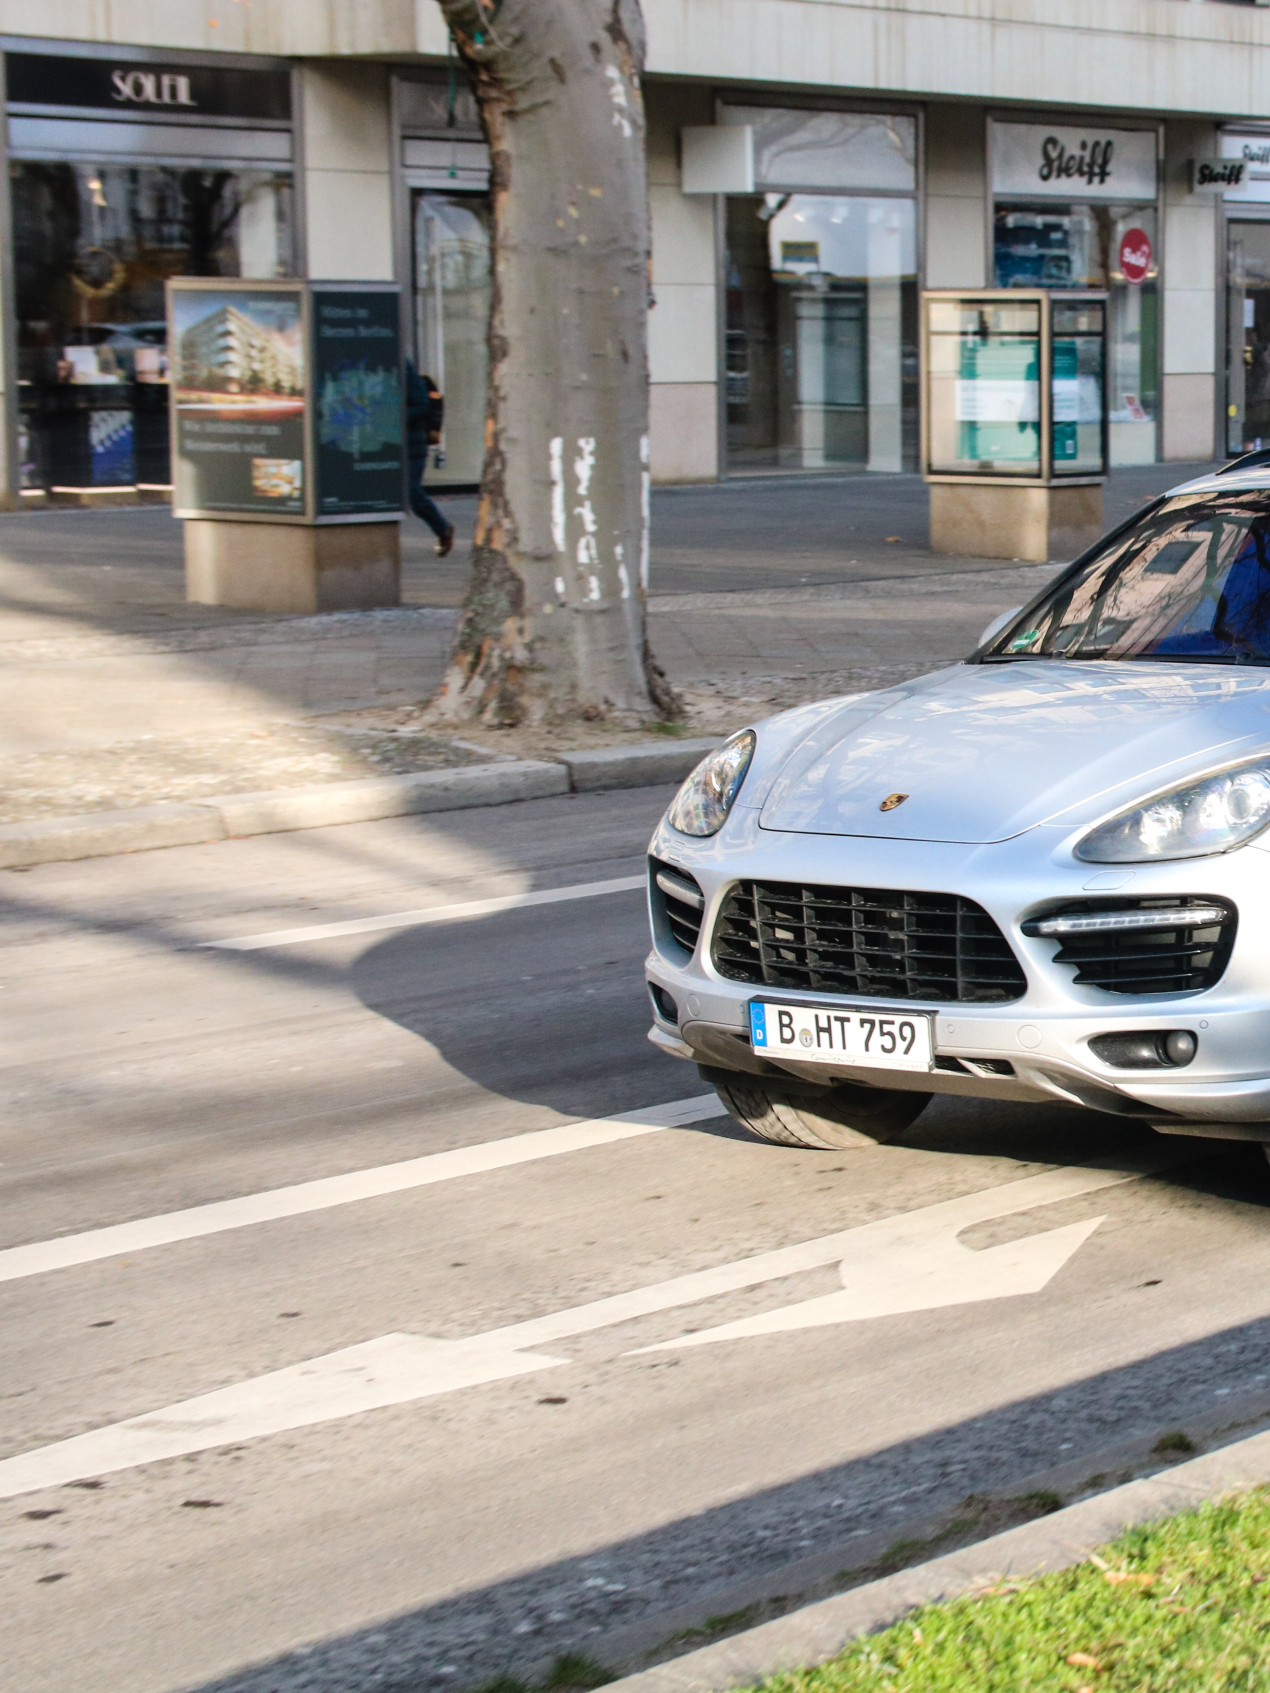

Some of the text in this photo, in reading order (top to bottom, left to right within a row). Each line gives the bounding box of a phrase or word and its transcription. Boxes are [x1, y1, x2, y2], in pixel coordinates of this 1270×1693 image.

[111, 69, 198, 106] SOLEIL
[1038, 135, 1114, 186] Steiff
[1197, 163, 1245, 185] Steiff
[756, 1029, 763, 1040] D
[778, 1009, 916, 1055] B HT 759
